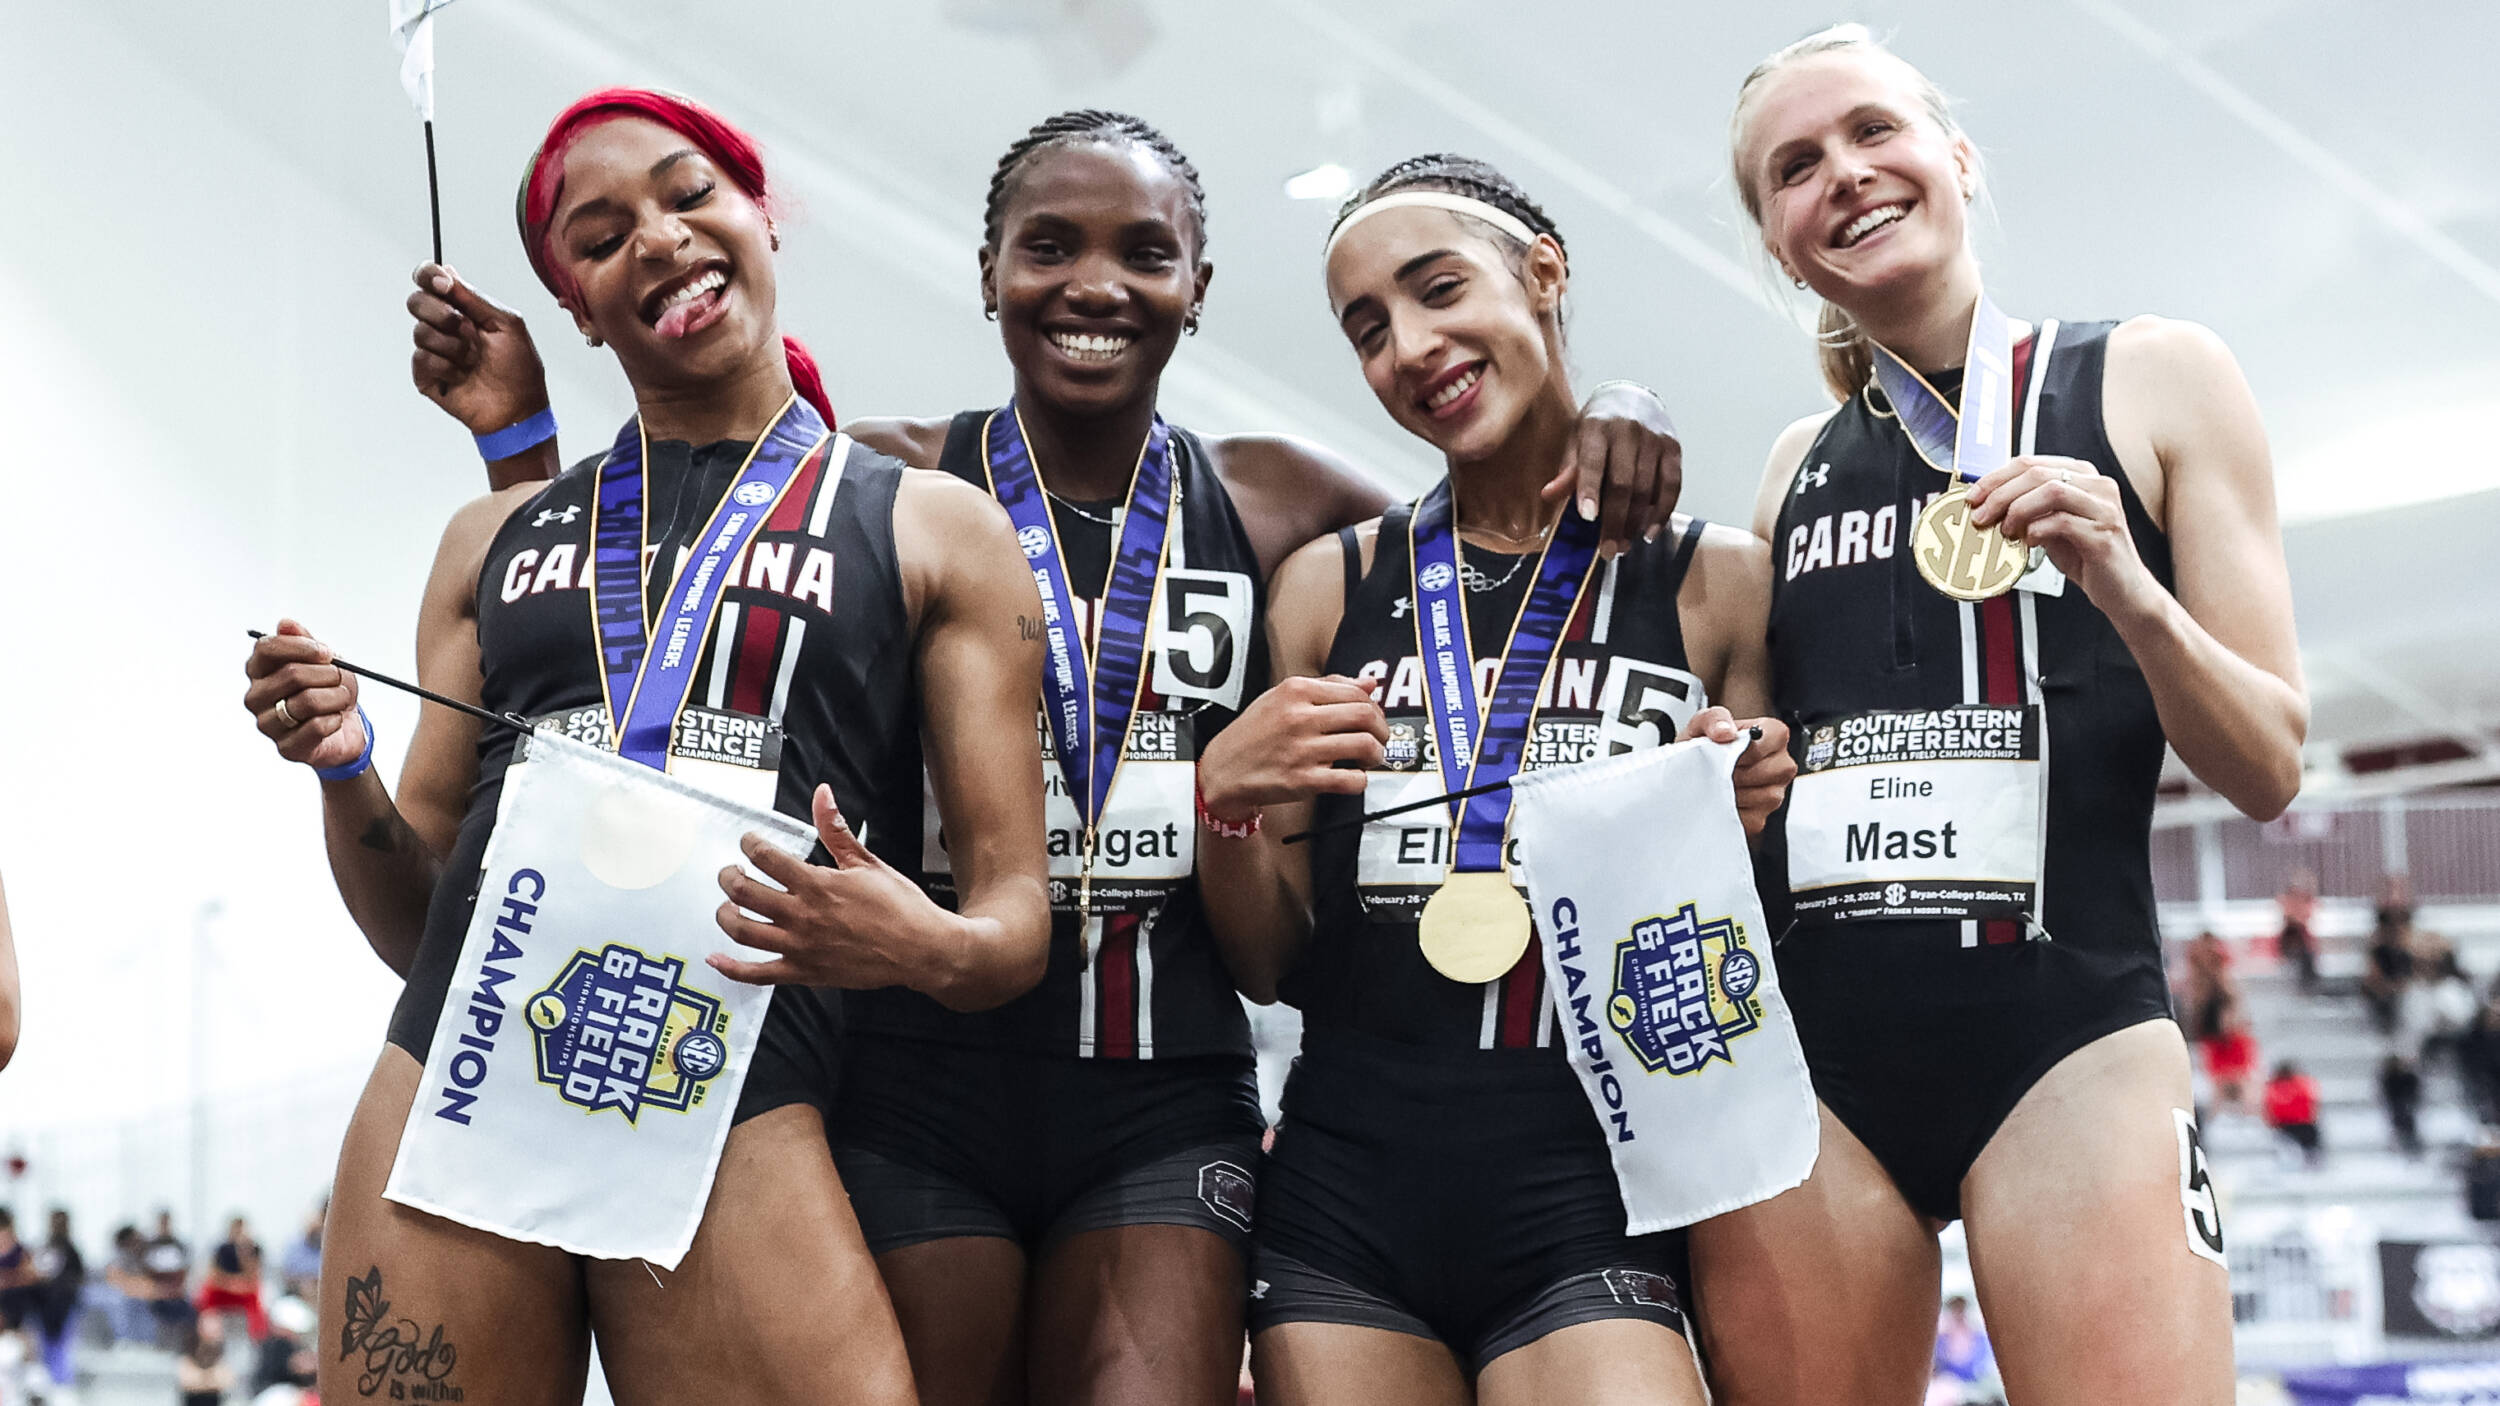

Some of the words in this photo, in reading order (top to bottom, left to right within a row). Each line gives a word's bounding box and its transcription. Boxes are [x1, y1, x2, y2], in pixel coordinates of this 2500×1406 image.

[1785, 497, 1921, 582] CARO
[1166, 577, 1234, 690] 5
[1609, 668, 1690, 757] 5
[1837, 729, 2022, 758] CONFERENCE
[1839, 710, 2022, 738] SOUTHEASTERN
[675, 746, 759, 768] CHAMPIONSHIPS
[1835, 756, 1868, 767] INDOOR
[1869, 752, 1900, 763] TRACK
[1901, 752, 1909, 761] &
[1910, 750, 1937, 761] FIELD
[1938, 749, 2021, 760] CHAMPIONSHIPS
[1870, 777, 1933, 799] Eline
[1846, 820, 1957, 863] Mast
[2012, 892, 2026, 901] TX
[603, 950, 638, 979] &
[1636, 923, 1665, 951] &
[1725, 957, 1754, 992] SEC
[435, 868, 545, 1125] CHAMPION
[559, 973, 594, 1065] CHAMPIONSHIPS
[1552, 897, 1635, 1142] CHAMPION
[1631, 958, 1658, 1050] CHAMPIONSHIPS
[1645, 959, 1695, 1070] FIELD
[1666, 910, 1727, 1061] TRACK
[565, 987, 627, 1101] FIELD
[598, 963, 677, 1112] TRACK
[655, 1025, 673, 1064] INDOOR
[682, 1037, 719, 1073] SEC
[2187, 1123, 2223, 1254] 5
[358, 1319, 457, 1397] God
